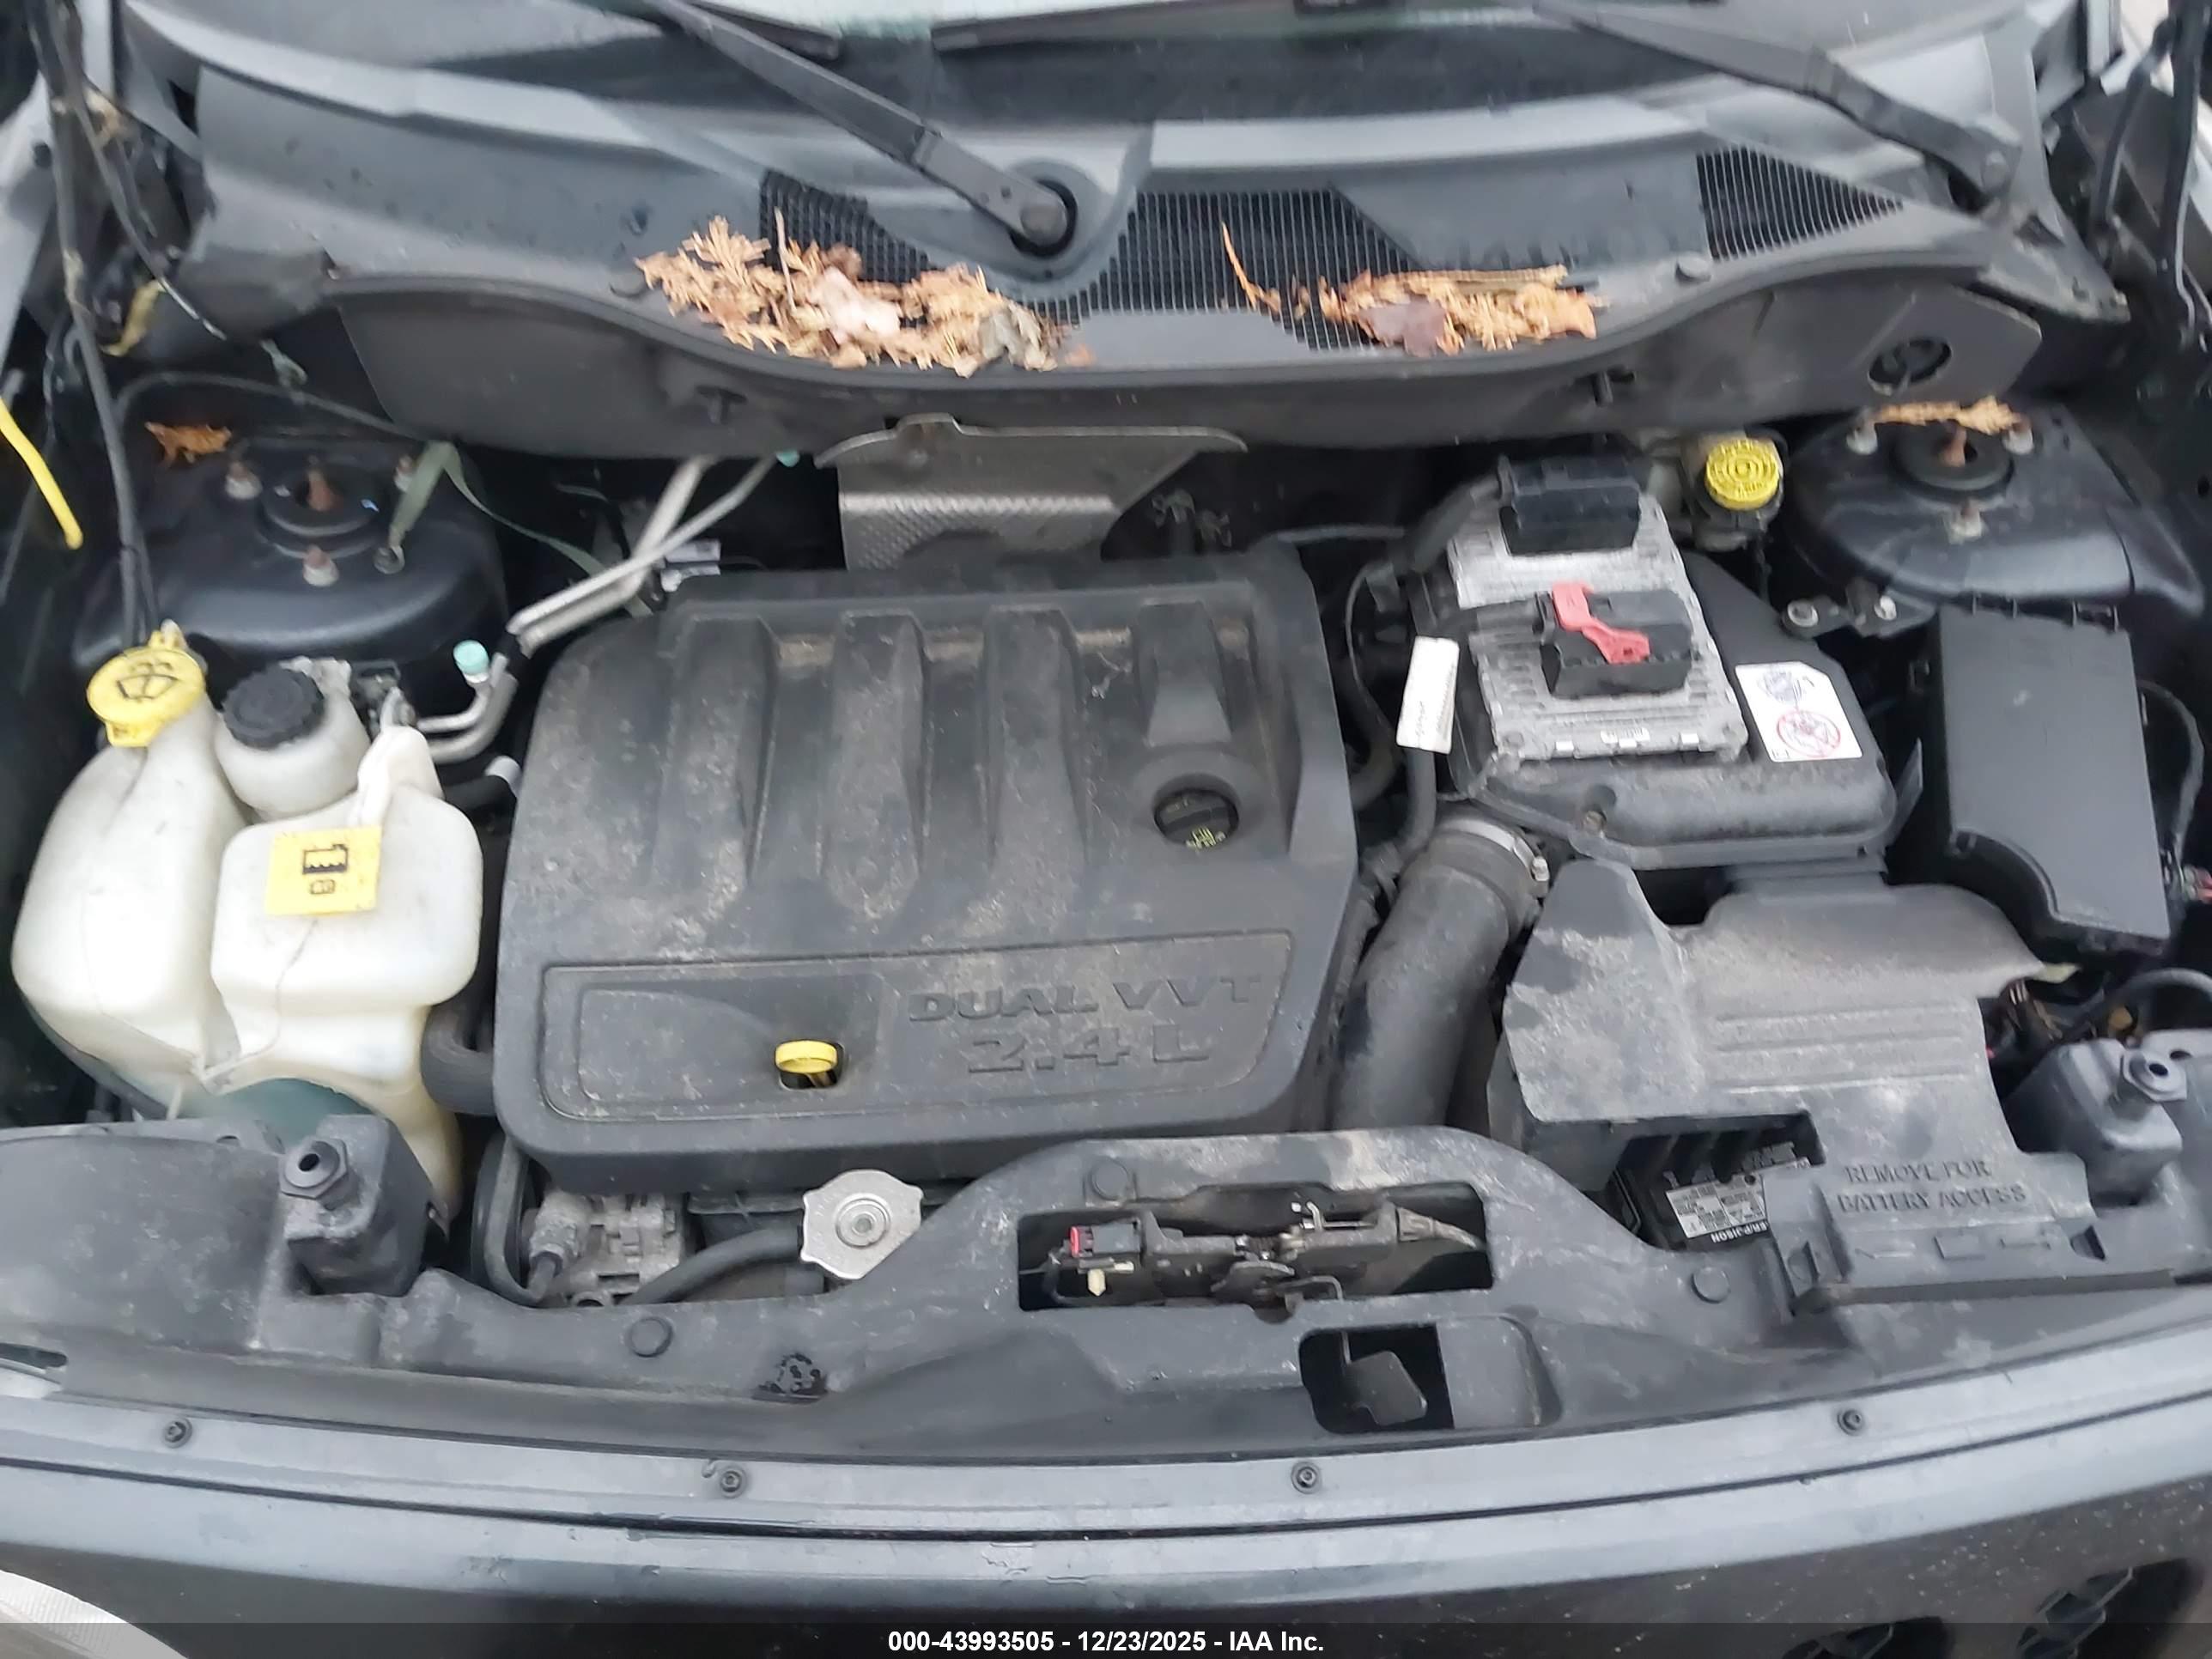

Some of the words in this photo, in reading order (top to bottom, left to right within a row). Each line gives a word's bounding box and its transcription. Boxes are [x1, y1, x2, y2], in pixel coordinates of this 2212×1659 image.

[908, 984, 1099, 1022] DUAL
[1113, 976, 1262, 1010] VVT
[1844, 1164, 1939, 1183] REMOVE
[1942, 1159, 1991, 1179] FOR
[1837, 1191, 1930, 1212] BATTERY
[1938, 1182, 2027, 1208] ACCESS
